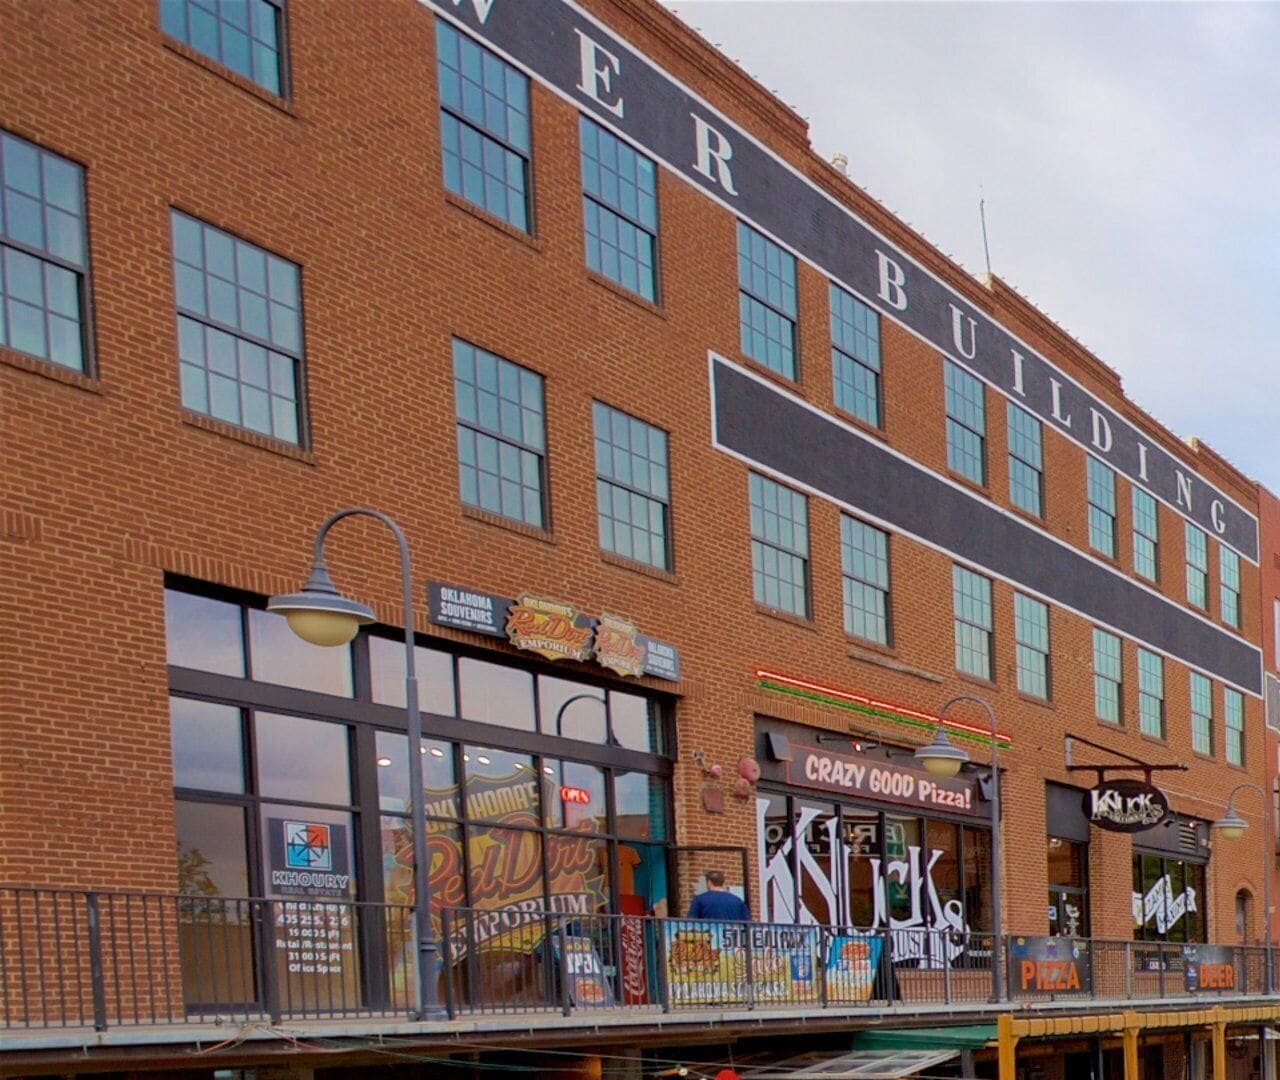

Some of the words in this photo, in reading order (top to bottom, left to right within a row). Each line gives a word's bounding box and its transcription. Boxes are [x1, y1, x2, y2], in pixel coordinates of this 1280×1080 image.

[455, 0, 738, 197] ER
[875, 249, 1227, 534] BUILDING
[440, 586, 493, 611] OKLAHOMA
[440, 600, 493, 625] SOUVENIRS
[520, 638, 582, 660] EMPORIUM
[805, 754, 866, 789] CRAZY
[868, 767, 915, 797] GOOD
[918, 780, 972, 809] Pizza!
[563, 787, 589, 803] OPEN
[272, 871, 351, 888] KHOURY
[1021, 960, 1080, 990] PIZZA
[1199, 964, 1234, 988] BEER
